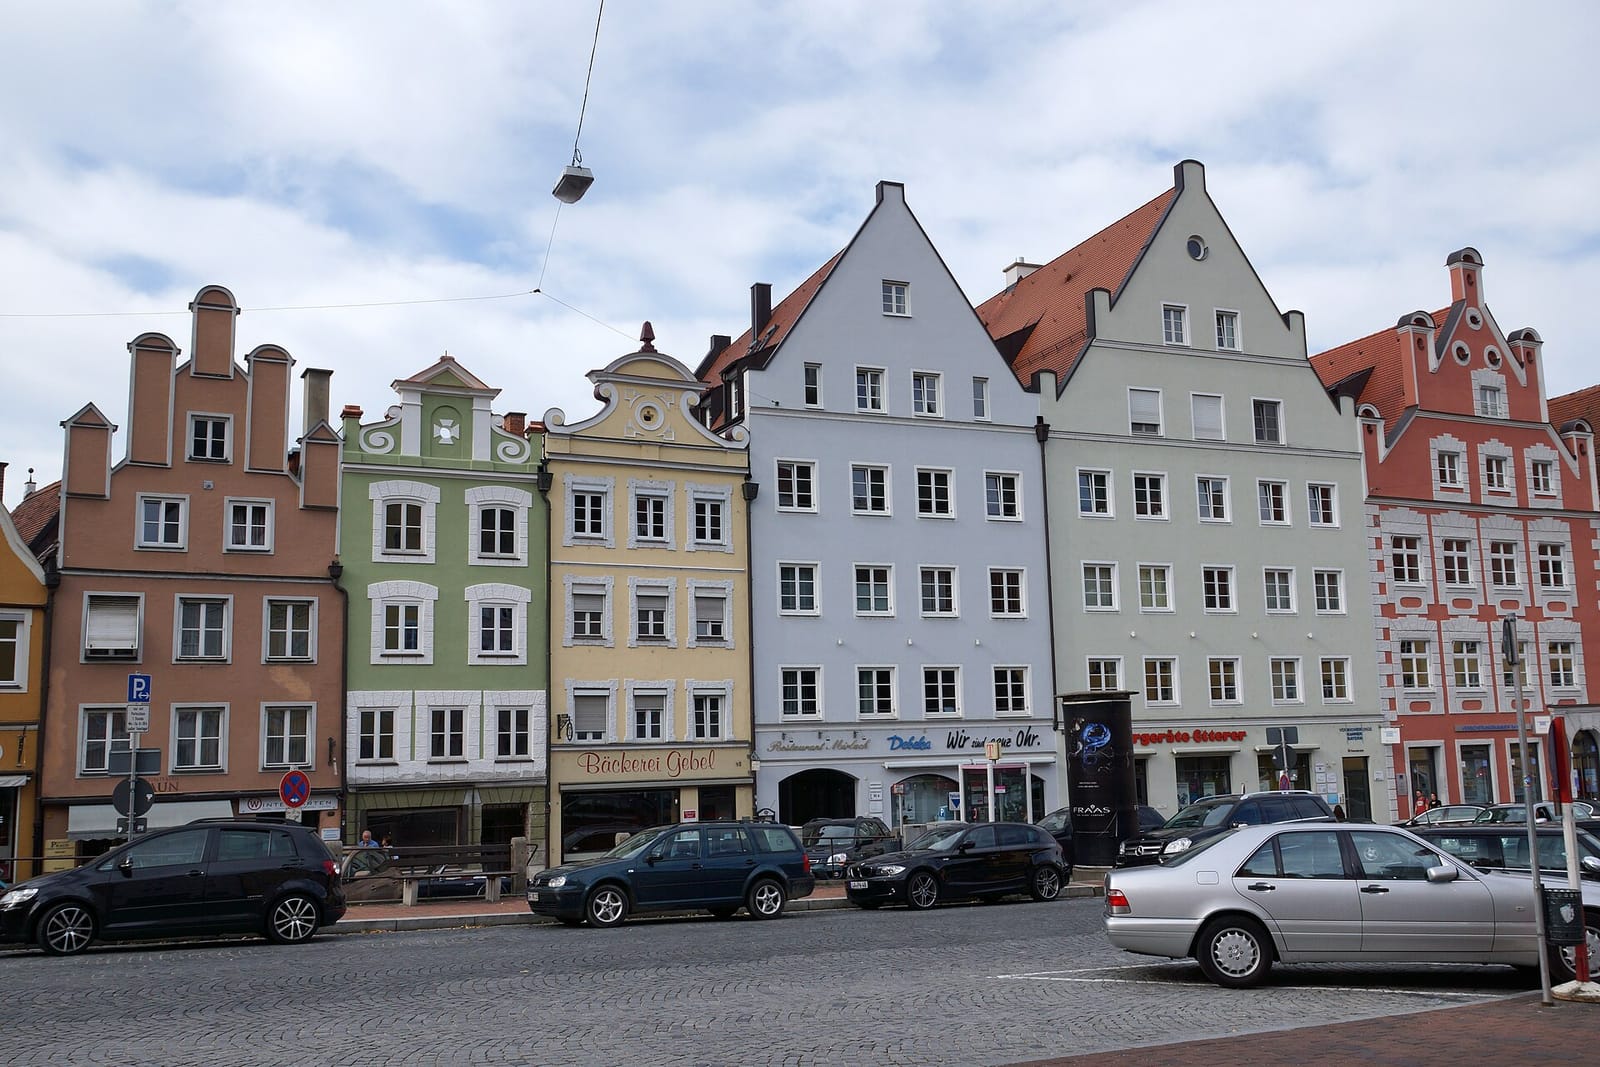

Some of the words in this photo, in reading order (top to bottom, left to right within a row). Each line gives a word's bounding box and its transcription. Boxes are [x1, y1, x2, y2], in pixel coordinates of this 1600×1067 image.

[133, 678, 146, 699] P
[887, 735, 931, 750] Debeka
[946, 729, 970, 749] Wir
[1016, 725, 1041, 748] Ohr.
[1132, 729, 1248, 746] rgeräte-Etterer
[577, 751, 661, 775] Bäckerei
[666, 748, 716, 778] Gebel
